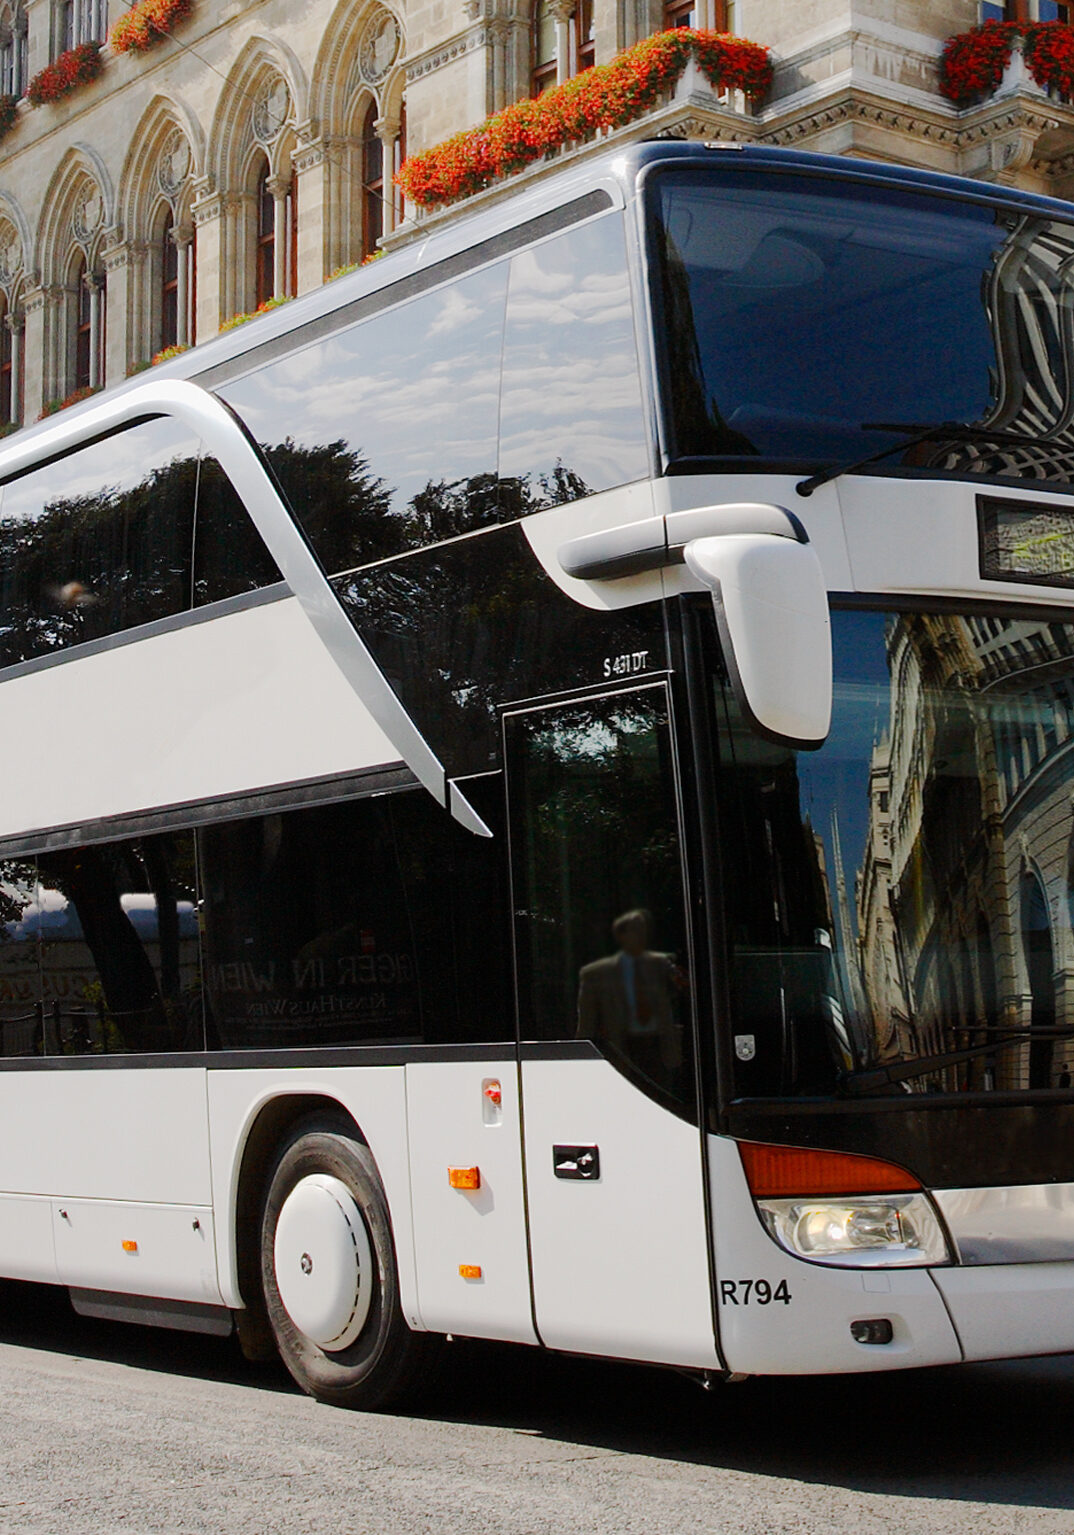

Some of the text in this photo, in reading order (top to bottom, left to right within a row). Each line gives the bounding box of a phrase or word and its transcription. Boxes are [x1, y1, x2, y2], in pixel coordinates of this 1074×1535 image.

[603, 650, 649, 677] S 431 DT
[720, 1279, 792, 1305] R794
